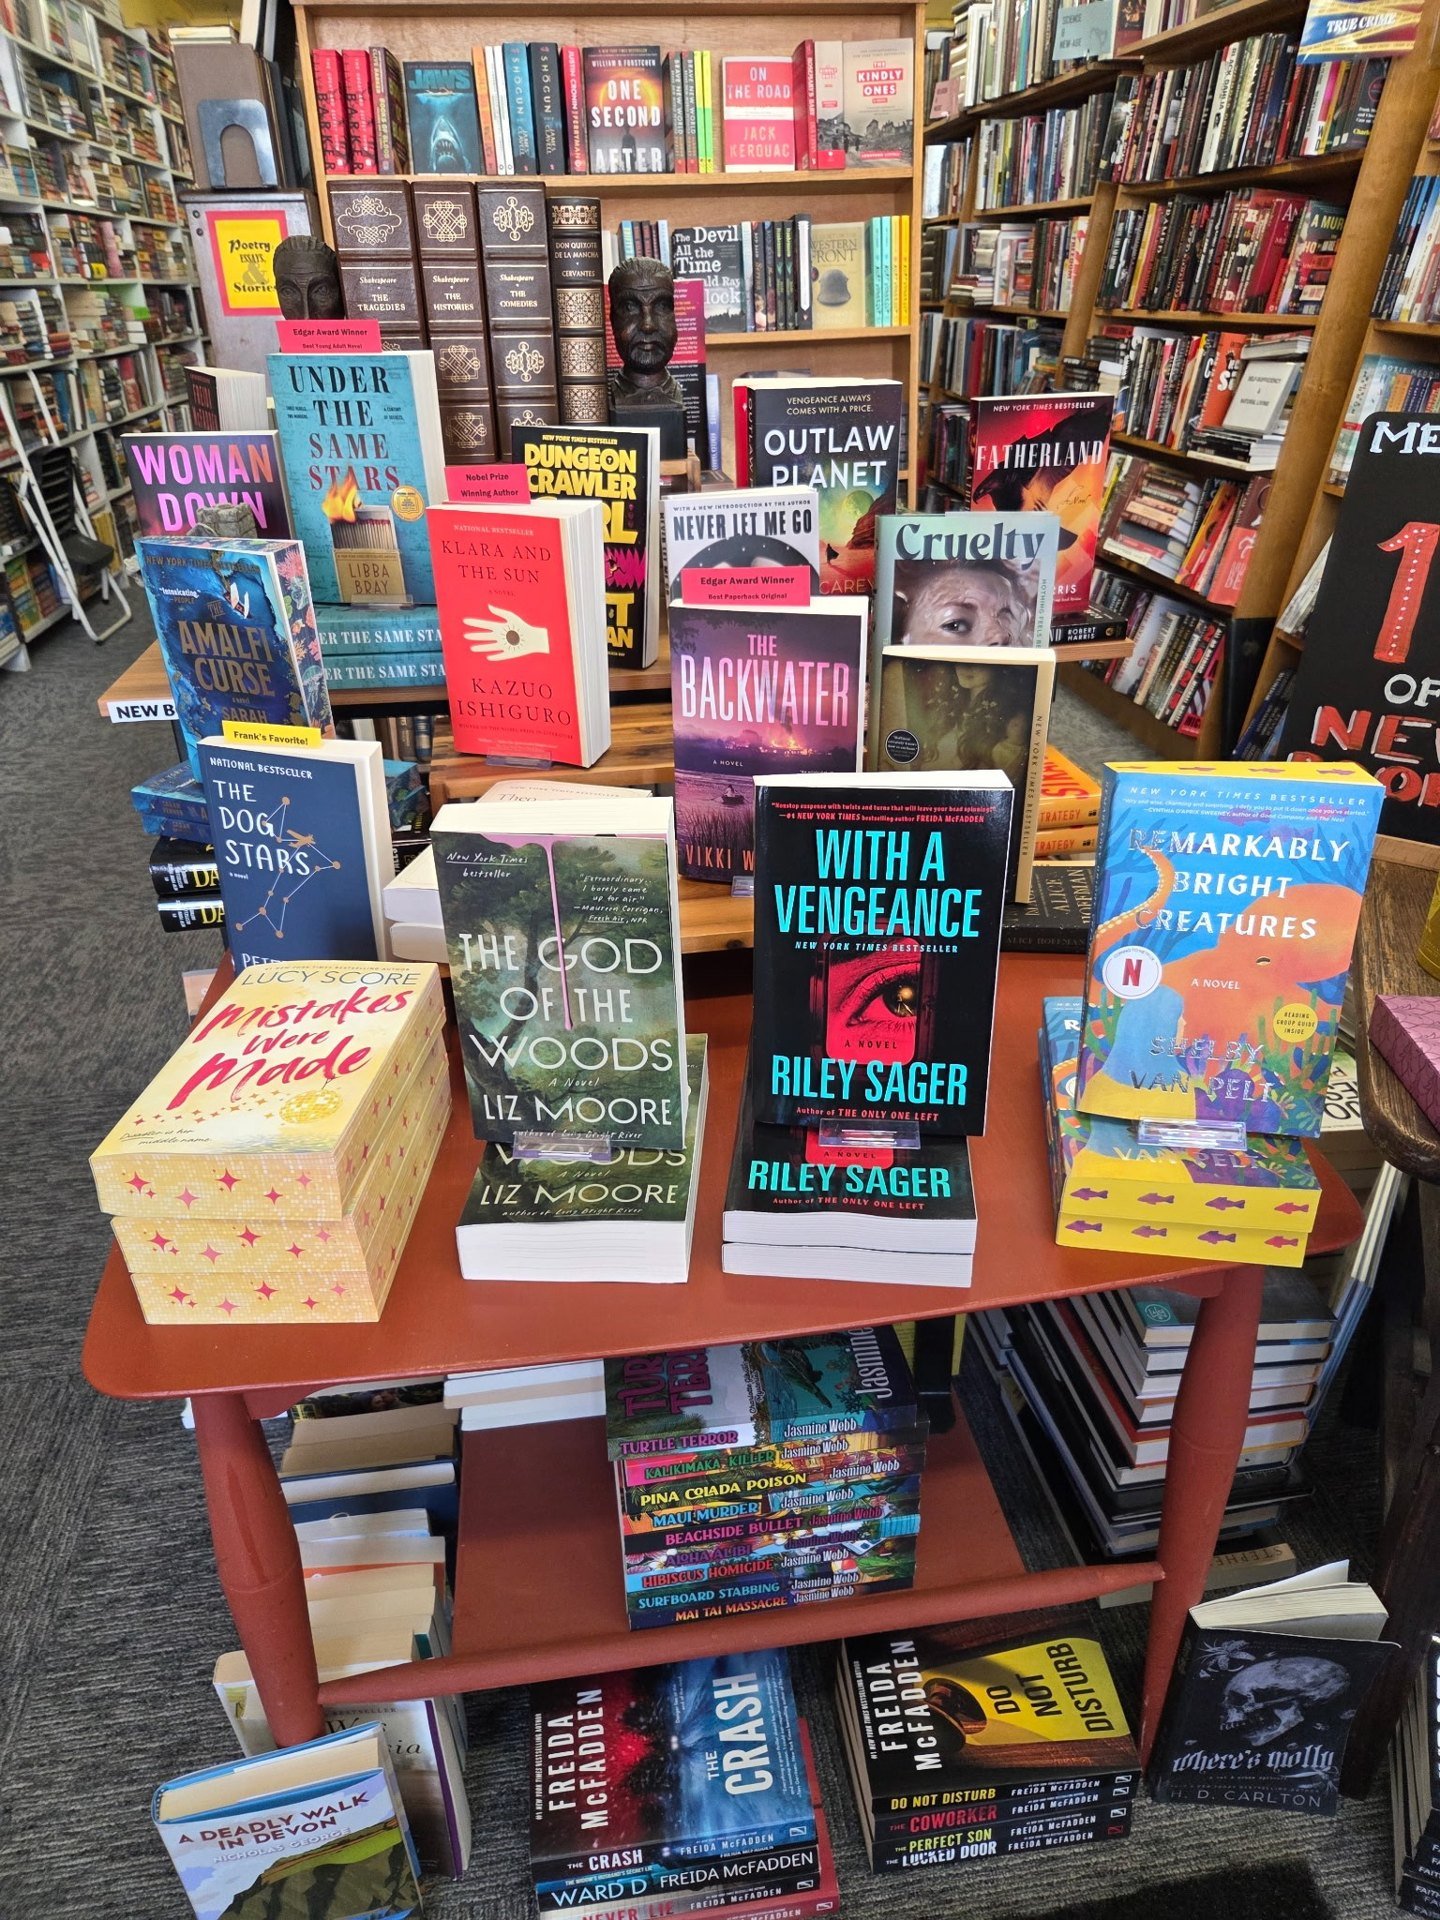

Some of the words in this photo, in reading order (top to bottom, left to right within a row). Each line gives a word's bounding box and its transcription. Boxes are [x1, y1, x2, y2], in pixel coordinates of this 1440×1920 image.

[1327, 18, 1358, 33] TRUE
[1359, 12, 1397, 28] CRIME
[409, 69, 471, 90] JAWS
[750, 67, 767, 81] ON
[858, 70, 902, 81] KINDLY
[608, 80, 641, 100] ONE
[728, 85, 750, 99] THE
[757, 85, 790, 98] ROAD
[864, 86, 896, 95] ONES
[592, 106, 660, 127] SECOND
[744, 127, 776, 140] JACK
[596, 148, 662, 173] AFTER
[730, 144, 790, 158] KEROUAC
[229, 240, 271, 253] Poetry
[675, 234, 690, 243] The
[694, 225, 739, 244] Devil
[677, 245, 691, 256] All
[695, 246, 713, 258] the
[678, 257, 721, 273] Time
[500, 300, 537, 308] COMEDIES
[293, 328, 313, 337] Edgar
[317, 328, 337, 336] Award
[340, 328, 367, 336] Winner
[288, 365, 390, 393] UNDER
[787, 396, 838, 405] VENGEANCE
[840, 395, 871, 403] ALWAYS
[787, 407, 816, 415] COMES
[850, 405, 873, 413] PRICE.
[313, 401, 373, 426] THE
[310, 433, 389, 460] SAME
[764, 425, 894, 456] OUTLAW
[131, 444, 273, 485] WOMAN
[524, 444, 636, 473] DUNGEON
[976, 440, 1104, 471] FATHERLAND
[309, 465, 400, 491] STARS
[527, 468, 636, 500] CRAWLER
[772, 459, 887, 490] PLANET
[461, 489, 492, 498] Winning
[493, 488, 518, 497] Author
[673, 512, 726, 541] NEVER
[733, 513, 759, 540] LET
[765, 510, 786, 536] ME
[793, 509, 811, 535] GO
[441, 540, 505, 558] KLARA
[513, 546, 551, 562] AND
[896, 522, 1045, 570] Cruelty
[349, 563, 389, 579] LIBBA
[457, 564, 496, 581] THE
[504, 568, 539, 584] SUN
[701, 577, 727, 586] Edgar
[729, 577, 758, 585] Award
[762, 576, 794, 584] Winner
[355, 579, 388, 595] BRAY
[725, 593, 759, 601] Paperback
[761, 592, 787, 600] Original
[177, 620, 274, 663] AMALFI
[747, 634, 777, 656] THE
[195, 657, 275, 697] CURSE
[473, 678, 552, 699] KAZUO
[681, 654, 850, 727] BACKWATER
[117, 705, 158, 719] NEW
[457, 700, 571, 726] ISHIGURO
[234, 731, 267, 742] Frank's
[269, 733, 308, 746] Favorite!
[210, 757, 255, 772] NATIONAL
[258, 764, 312, 779] BESTSELLER
[213, 780, 256, 802] THE
[219, 806, 275, 837] DOG
[815, 829, 910, 881] WITH
[920, 832, 945, 881] A
[1129, 828, 1349, 862] REMARKABLY
[225, 841, 311, 876] STARS
[1173, 871, 1293, 899] BRIGHT
[774, 884, 982, 938] VENGEANCE
[1135, 908, 1317, 940] CREATURES
[459, 934, 520, 971] THE
[538, 937, 663, 974] GOD
[796, 941, 818, 949] NEW
[856, 943, 888, 951] TIMES
[892, 944, 958, 953] BESTSELLER
[242, 970, 318, 986] LUCY
[320, 971, 421, 986] SCORE
[1191, 978, 1200, 986] A
[1203, 979, 1240, 990] NOVEL
[192, 987, 414, 1043] Mistakes
[500, 986, 554, 1021] OF
[574, 988, 634, 1023] THE
[242, 1028, 332, 1056] Were
[469, 1034, 673, 1071] WOODS
[165, 1035, 372, 1111] Made
[771, 1055, 857, 1100] RILEY
[865, 1060, 968, 1105] SAGER
[484, 1095, 522, 1121] LIZ
[535, 1097, 672, 1125] MOORE
[621, 1437, 675, 1455] TURTLE
[680, 1431, 738, 1447] TERROR
[645, 1458, 720, 1479] KALIKIMAKA
[729, 1451, 776, 1467] KILLER
[641, 1492, 679, 1506] PINA
[685, 1483, 740, 1500] COLADA
[747, 1474, 806, 1490] POISON
[653, 1512, 693, 1527] MAUI
[696, 1503, 758, 1522] MURDER
[665, 1525, 744, 1545] BEACHSIDE
[749, 1517, 803, 1535] BULLET
[643, 1570, 704, 1588] HIBISCUS
[709, 1560, 773, 1578] HOMICIDE
[639, 1591, 714, 1608] SURFBOARD
[719, 1583, 779, 1599] STABBING
[676, 1608, 699, 1621] MAI
[703, 1605, 722, 1617] TAI
[726, 1597, 787, 1614] MASSACRE
[986, 1686, 1020, 1714] DO
[1016, 1673, 1062, 1717] NOT
[1046, 1642, 1115, 1732] DISTURB
[867, 1662, 908, 1752] FREIDA
[712, 1672, 773, 1795] CRASH
[548, 1714, 576, 1811] FREIDA
[705, 1750, 720, 1780] THE
[1225, 1790, 1321, 1808] CARLTON
[179, 1834, 193, 1844] A
[200, 1816, 292, 1841] DEADLY
[301, 1792, 369, 1820] WALK
[910, 1806, 997, 1832] COWORKER
[218, 1839, 244, 1850] IN
[253, 1817, 337, 1844] DEVON
[909, 1834, 962, 1852] PERFECT
[968, 1829, 992, 1842] SON
[902, 1849, 954, 1867] LOCKED
[960, 1841, 997, 1858] DOOR
[552, 1881, 624, 1906] WARD
[632, 1879, 647, 1894] D
